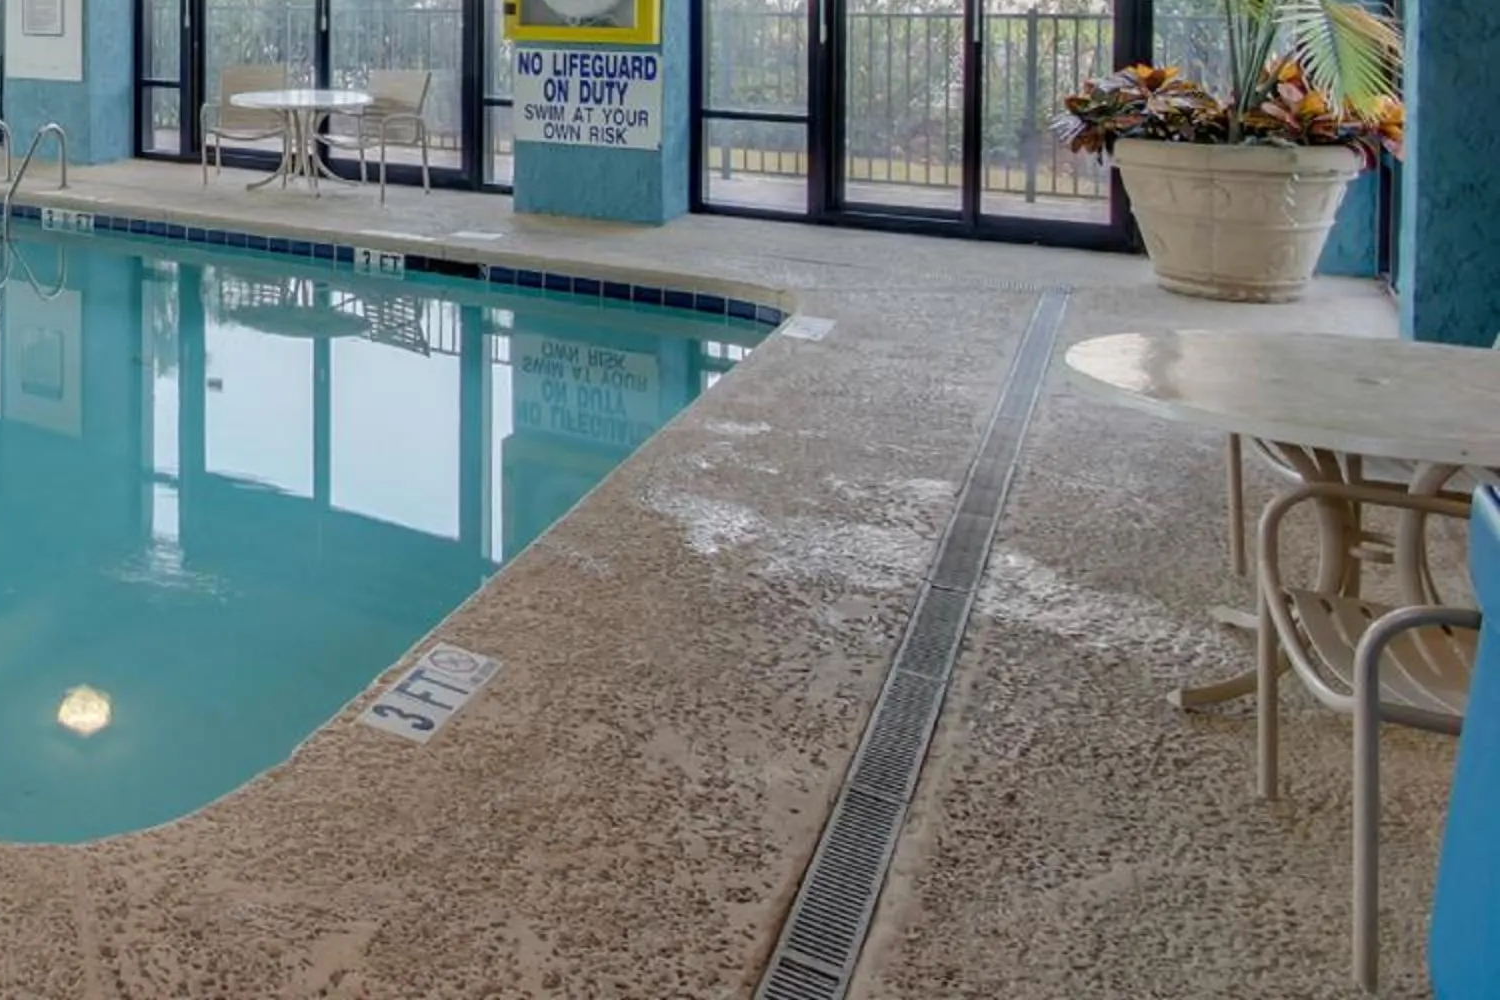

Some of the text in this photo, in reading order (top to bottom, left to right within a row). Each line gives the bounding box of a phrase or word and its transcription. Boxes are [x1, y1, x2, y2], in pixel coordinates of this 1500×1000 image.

[518, 52, 657, 80] NO LIFEGUARD
[543, 79, 628, 106] ON DUTY
[524, 104, 649, 127] SWIM AT YOUR
[543, 123, 627, 145] OWN RISK
[394, 668, 469, 711] FT
[372, 704, 435, 731] 3
